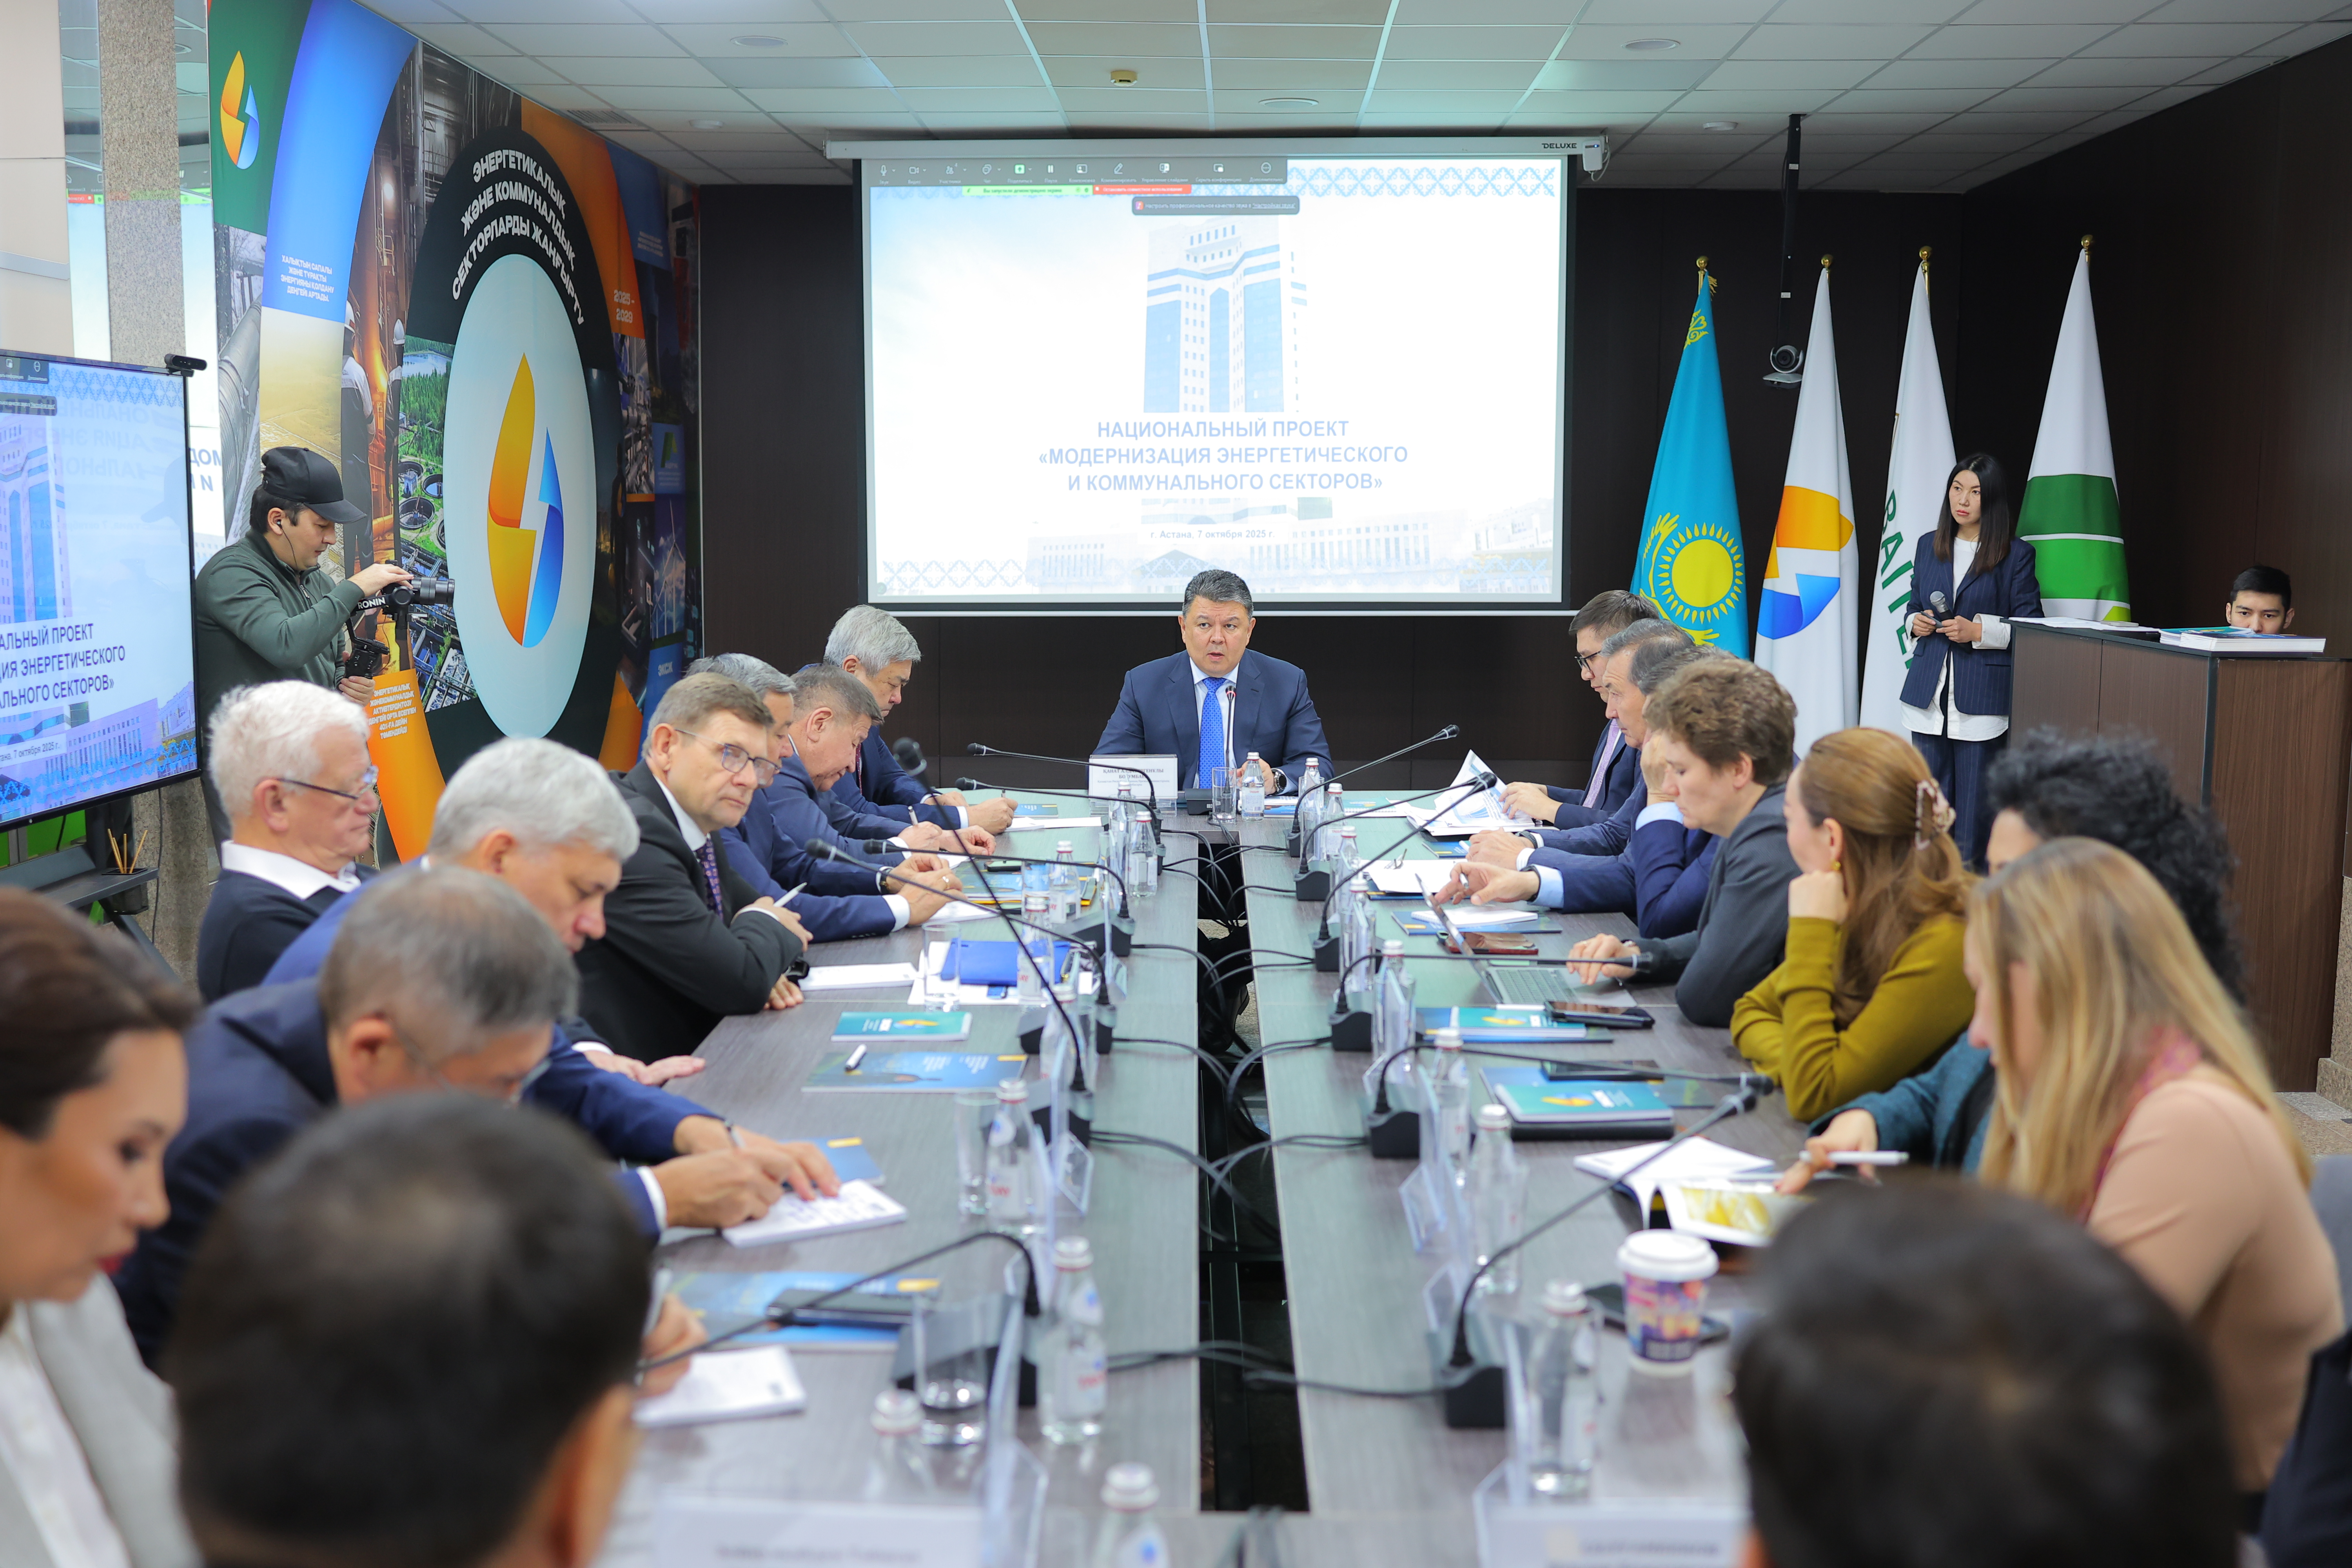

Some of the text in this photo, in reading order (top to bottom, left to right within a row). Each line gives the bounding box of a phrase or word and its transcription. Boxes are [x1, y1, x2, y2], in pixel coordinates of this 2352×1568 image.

[473, 149, 566, 220] ЭНЕРГЕТИКАЛЫҚ
[461, 181, 575, 272] ЖӘНЕ КОММУНАЛДЫҚ
[282, 255, 332, 274] ХАЛЫҚТЫҢ САПАЛЫ
[452, 215, 584, 325] СЕКТОРЛАРДЫ ЖАҢҒЫРТУ
[281, 274, 334, 293] ЭНЕРГИЯНЫ ҚОЛДАНУ
[289, 266, 327, 283] ЖӘНЕ ТҰРАҚТЫ
[1098, 418, 1349, 441] НАЦИОНАЛЬНЫЙ ПРОЕКТ
[1039, 446, 1408, 467] «МОДЕРНИЗАЦИЯ ЭНЕРГЕТИЧЕСКОГО
[1068, 473, 1383, 491] И КОММУНАЛЬНОГО СЕКТОРОВ»
[1160, 530, 1194, 539] Астана,
[1198, 530, 1203, 538] 7
[1205, 530, 1242, 540] октября
[1245, 530, 1266, 538] 2025
[358, 597, 386, 609] RONIN
[52, 623, 94, 644] ПРОЕКТ
[0, 645, 125, 683] ИЯ ЭНЕРГЕТИЧЕСКОГО
[53, 674, 114, 699] СЕКТОРОВ»
[374, 683, 410, 697] ЭНЕРГЕТИКАЛЫҚ
[387, 711, 397, 720] ОРТА
[398, 706, 417, 718] ЕСЕППЕН
[13, 750, 17, 758] 7
[18, 746, 41, 757] октября
[42, 742, 54, 752] 2025
